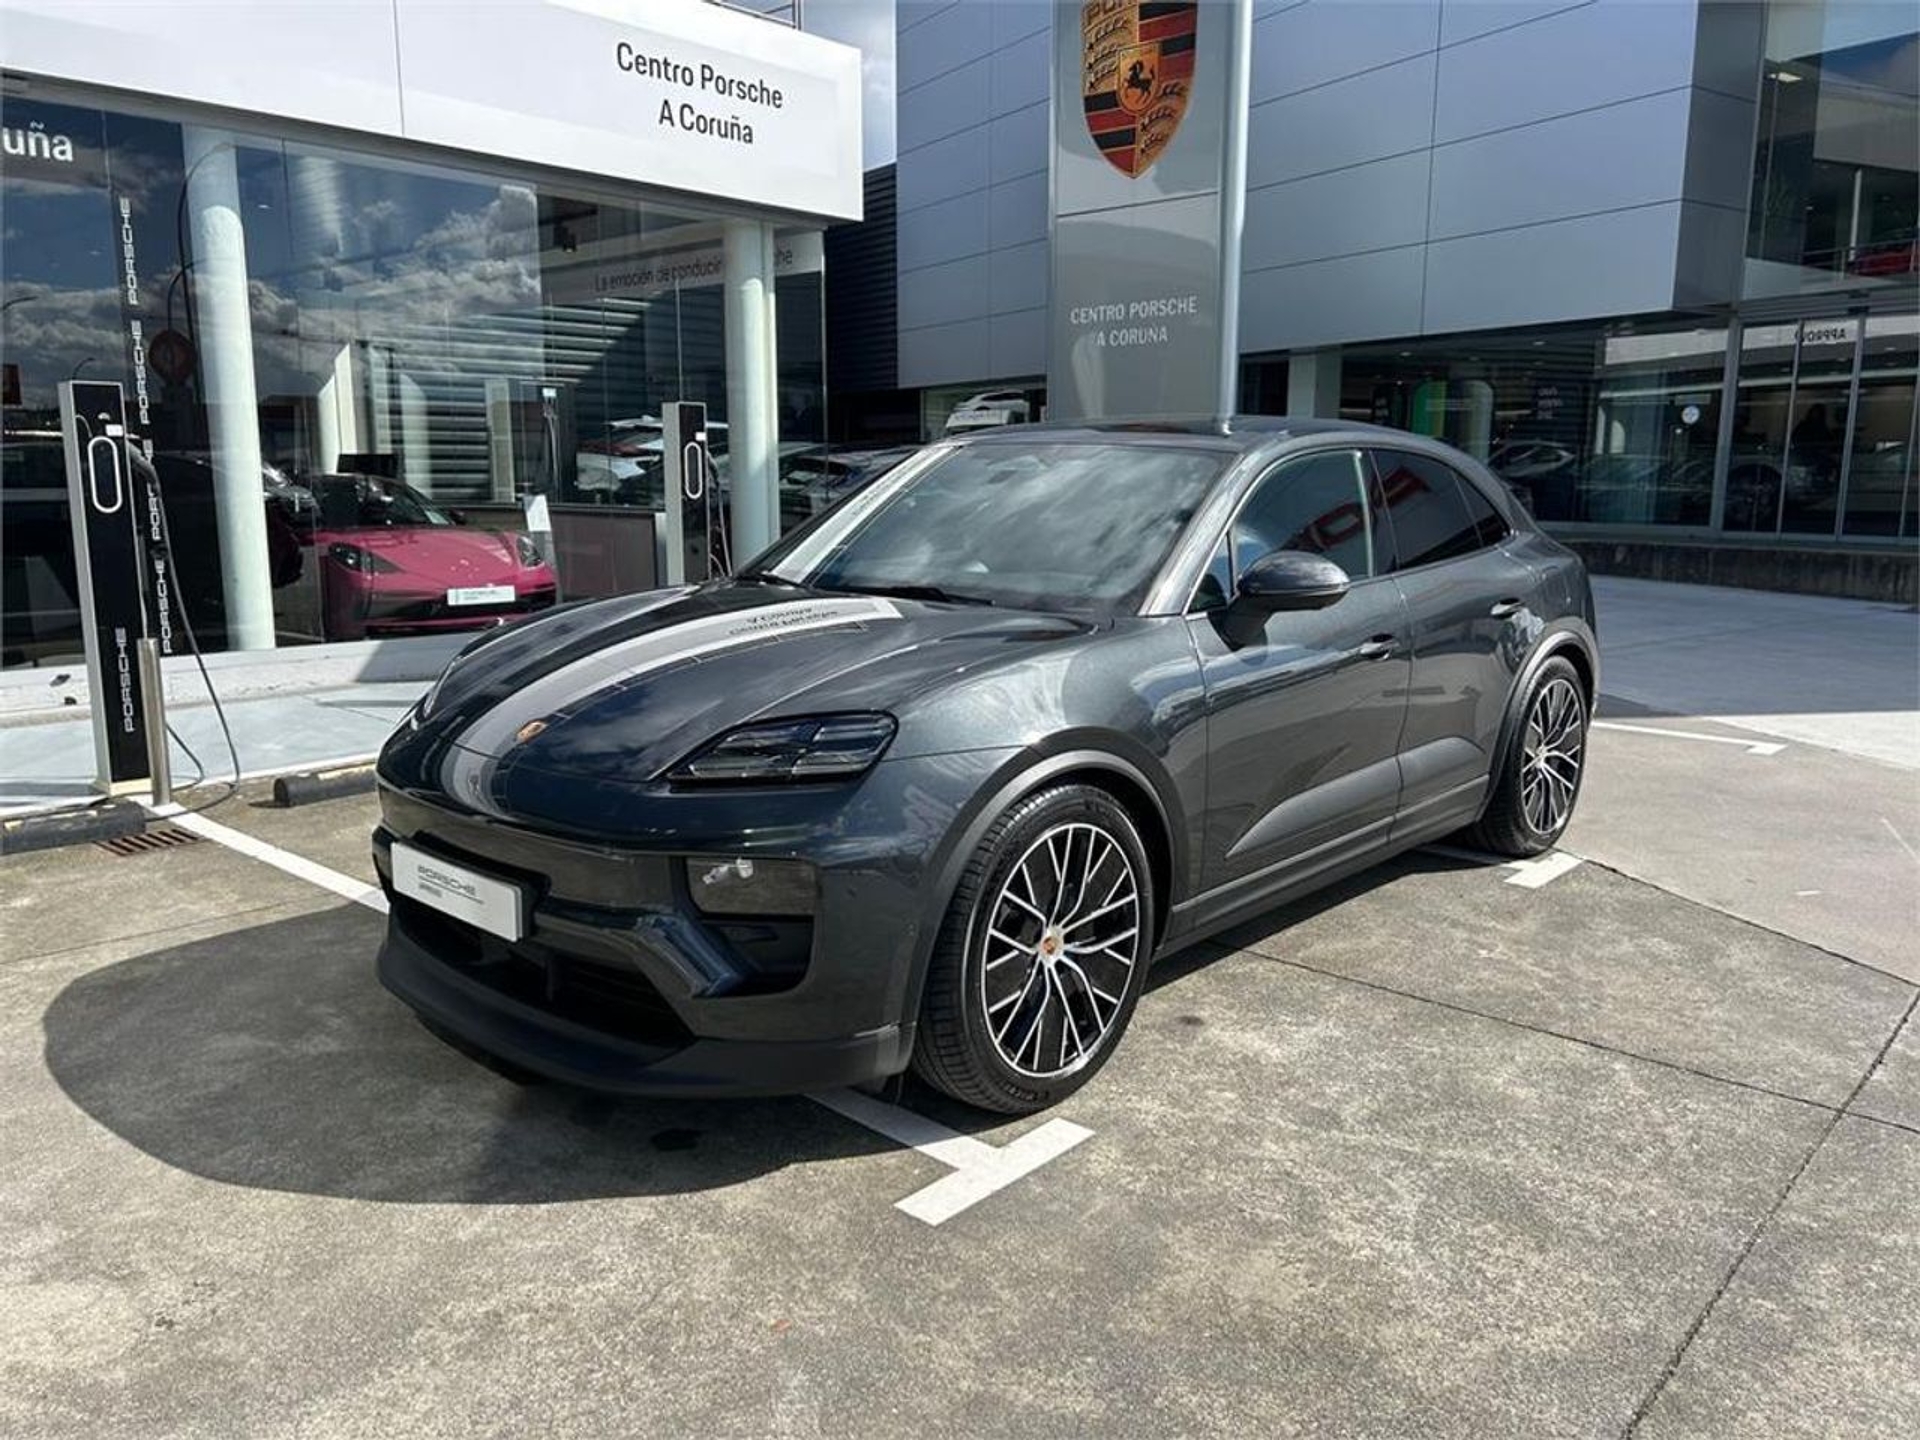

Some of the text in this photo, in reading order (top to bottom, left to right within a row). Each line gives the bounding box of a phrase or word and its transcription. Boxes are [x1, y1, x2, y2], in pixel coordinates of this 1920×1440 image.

[616, 41, 783, 109] Centro Porsche
[659, 98, 754, 144] A Coruña
[119, 197, 138, 306] PORSCHE
[1070, 295, 1198, 324] CENTRO PORSCHE
[1097, 330, 1106, 347] A
[131, 320, 150, 424] PORSCHE
[154, 560, 173, 654] PORSCHE
[115, 627, 135, 732] PORSCHE
